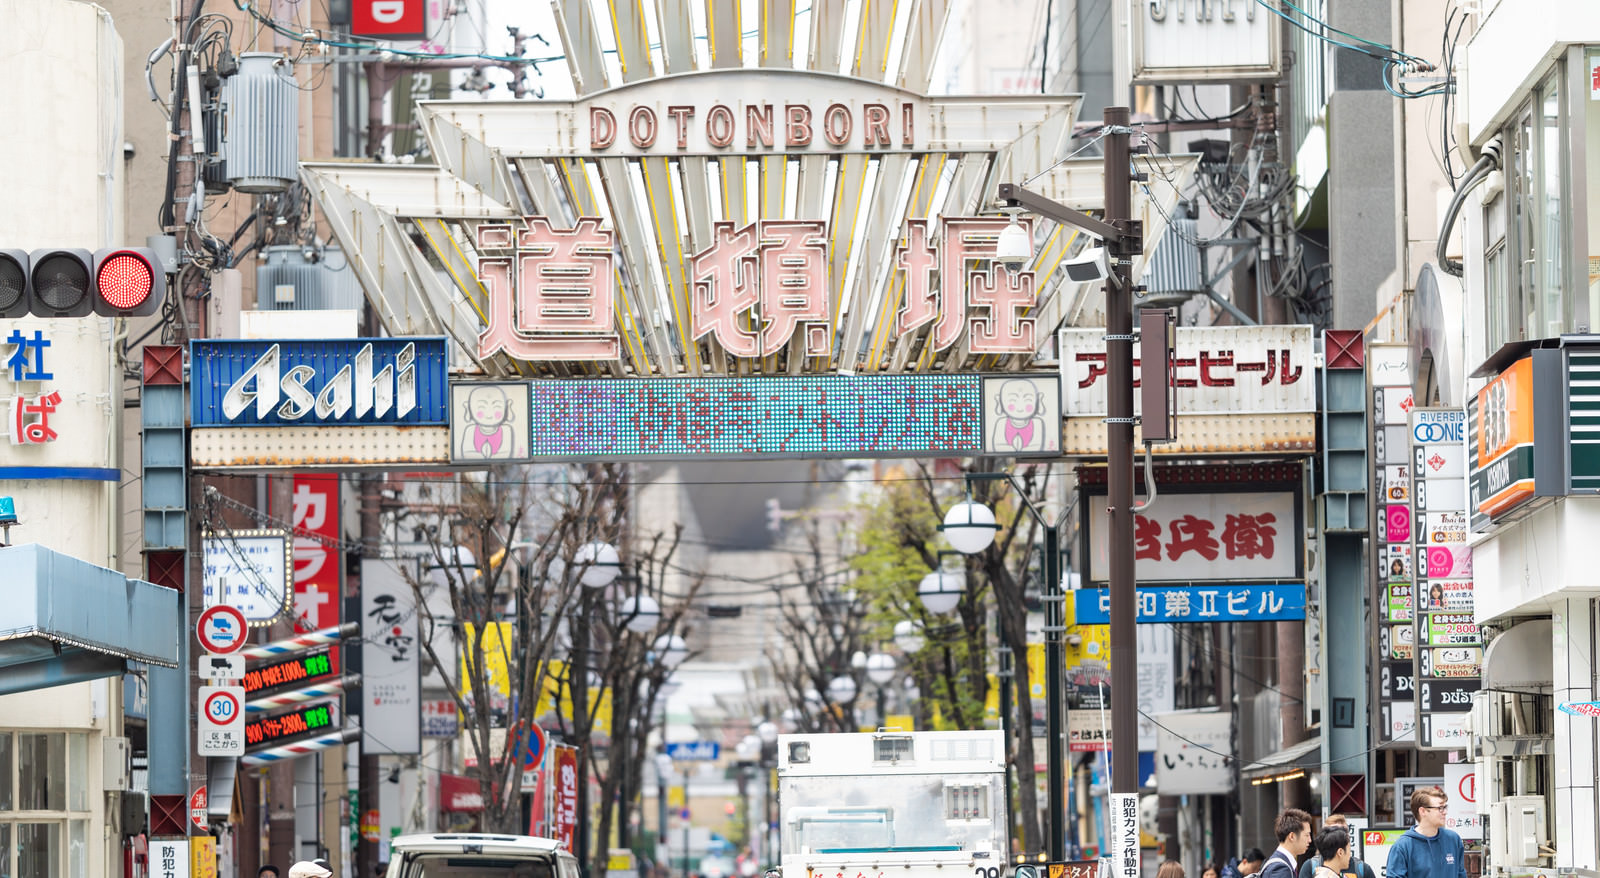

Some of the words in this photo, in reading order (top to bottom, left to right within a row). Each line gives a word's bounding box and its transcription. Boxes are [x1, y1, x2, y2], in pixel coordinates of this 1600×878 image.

[589, 101, 914, 149] DOTONBORI
[222, 342, 417, 421] Asahi
[1076, 348, 1303, 390] アヒビール
[1416, 448, 1425, 475] 9
[1417, 481, 1426, 509] 8
[1417, 513, 1426, 542] 7
[1419, 548, 1428, 576] 6
[1419, 582, 1429, 609] 5
[1420, 615, 1429, 643] 4
[1420, 649, 1429, 677] 3
[212, 700, 232, 716] 30
[1421, 682, 1431, 711] 2
[1422, 716, 1430, 743] 1
[1122, 797, 1137, 878] 防犯カメラ作動中
